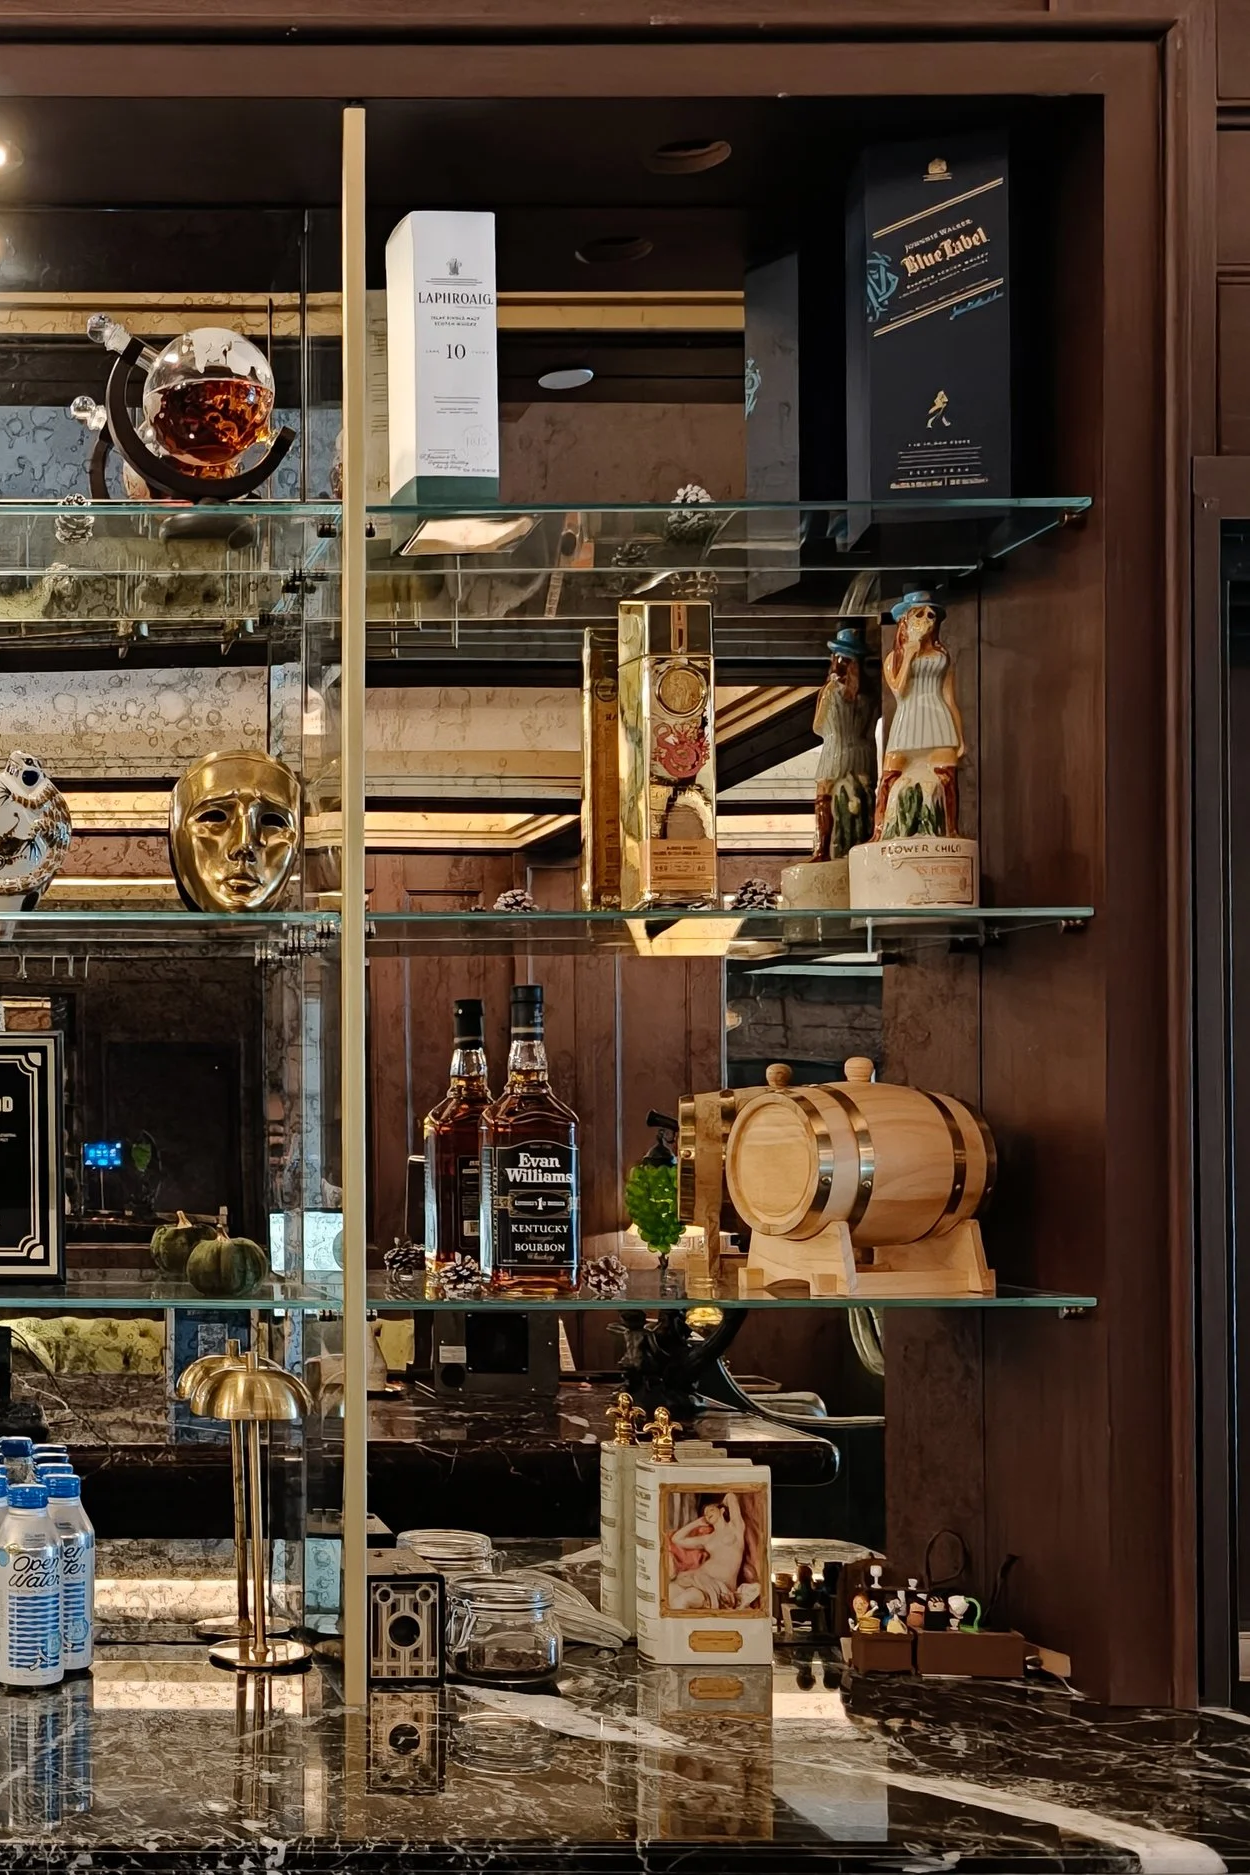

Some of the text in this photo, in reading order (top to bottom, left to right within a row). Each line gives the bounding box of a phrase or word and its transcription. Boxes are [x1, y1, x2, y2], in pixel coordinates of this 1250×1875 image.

[900, 249, 944, 277] Blue
[446, 343, 466, 360] 10
[880, 843, 962, 856] FLOWER CHILD
[518, 1152, 561, 1168] Evan
[505, 1168, 573, 1184] Williams
[511, 1224, 569, 1233] KENTUCKY
[514, 1243, 566, 1252] BOURBON
[13, 1556, 60, 1574] Open
